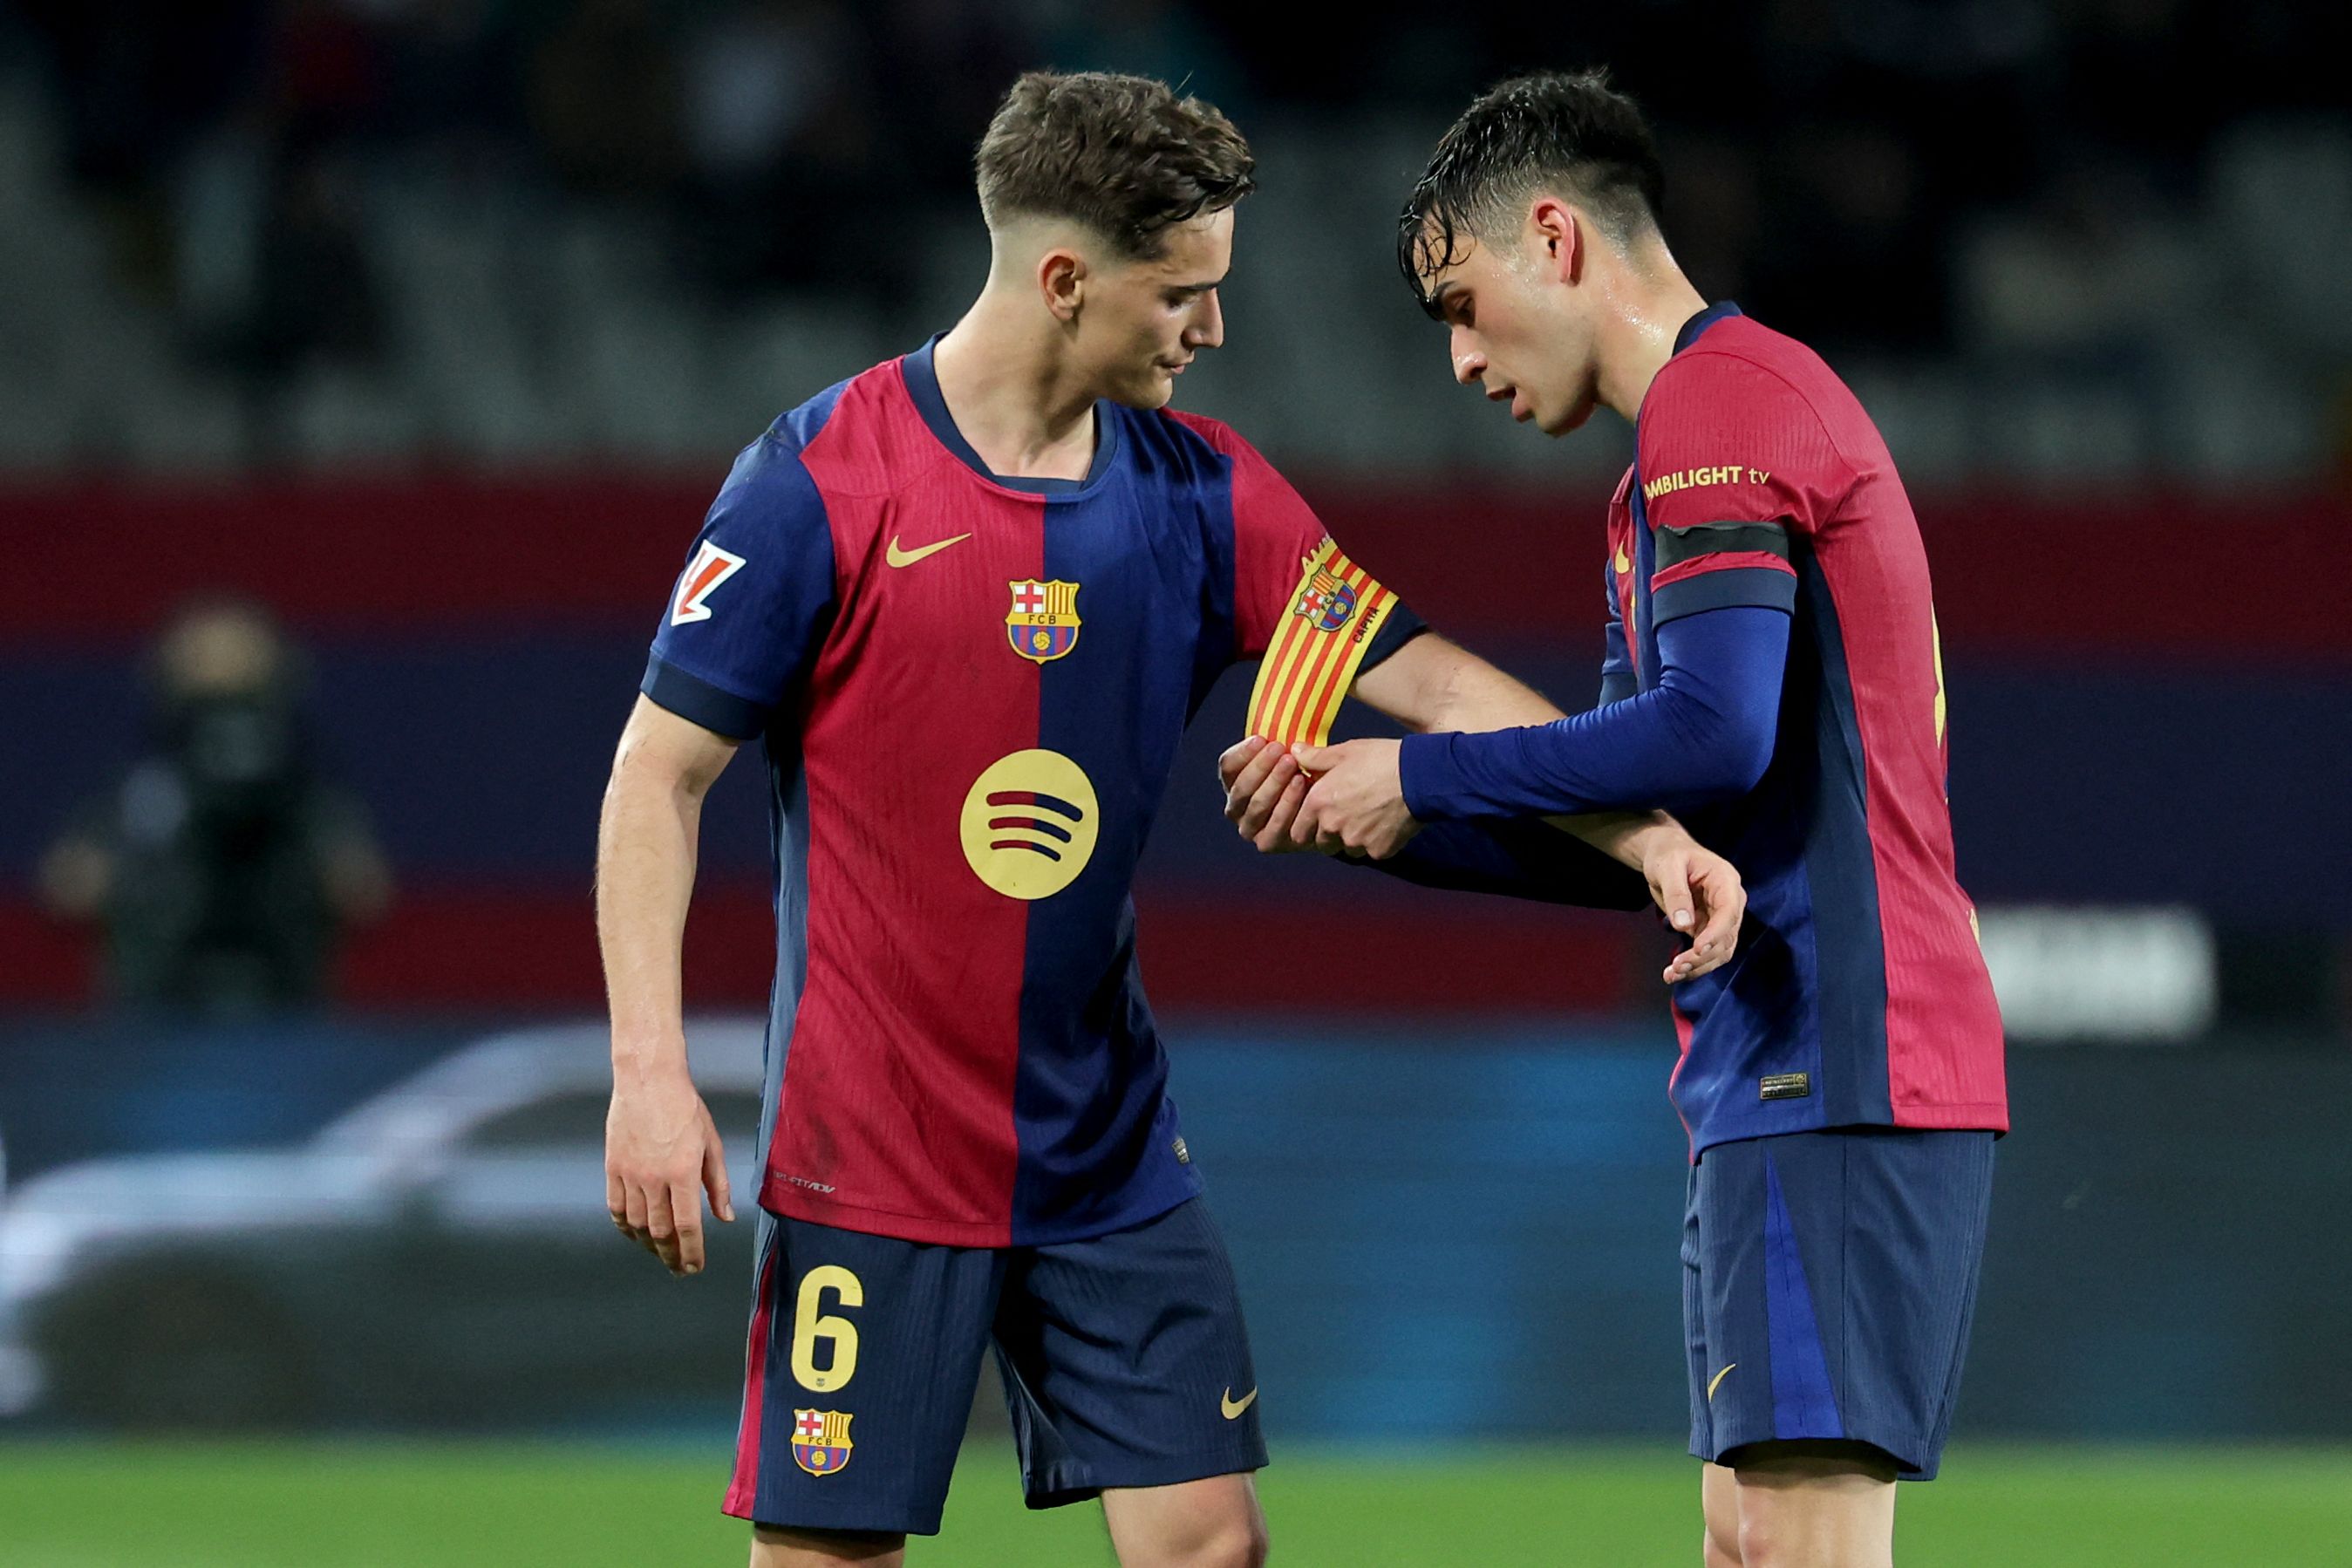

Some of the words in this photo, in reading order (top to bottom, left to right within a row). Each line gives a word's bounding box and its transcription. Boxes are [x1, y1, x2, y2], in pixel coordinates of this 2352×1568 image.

[1749, 467, 1770, 485] tv
[1028, 615, 1057, 624] FCB
[791, 1265, 863, 1393] 6
[808, 1435, 833, 1447] FCB
